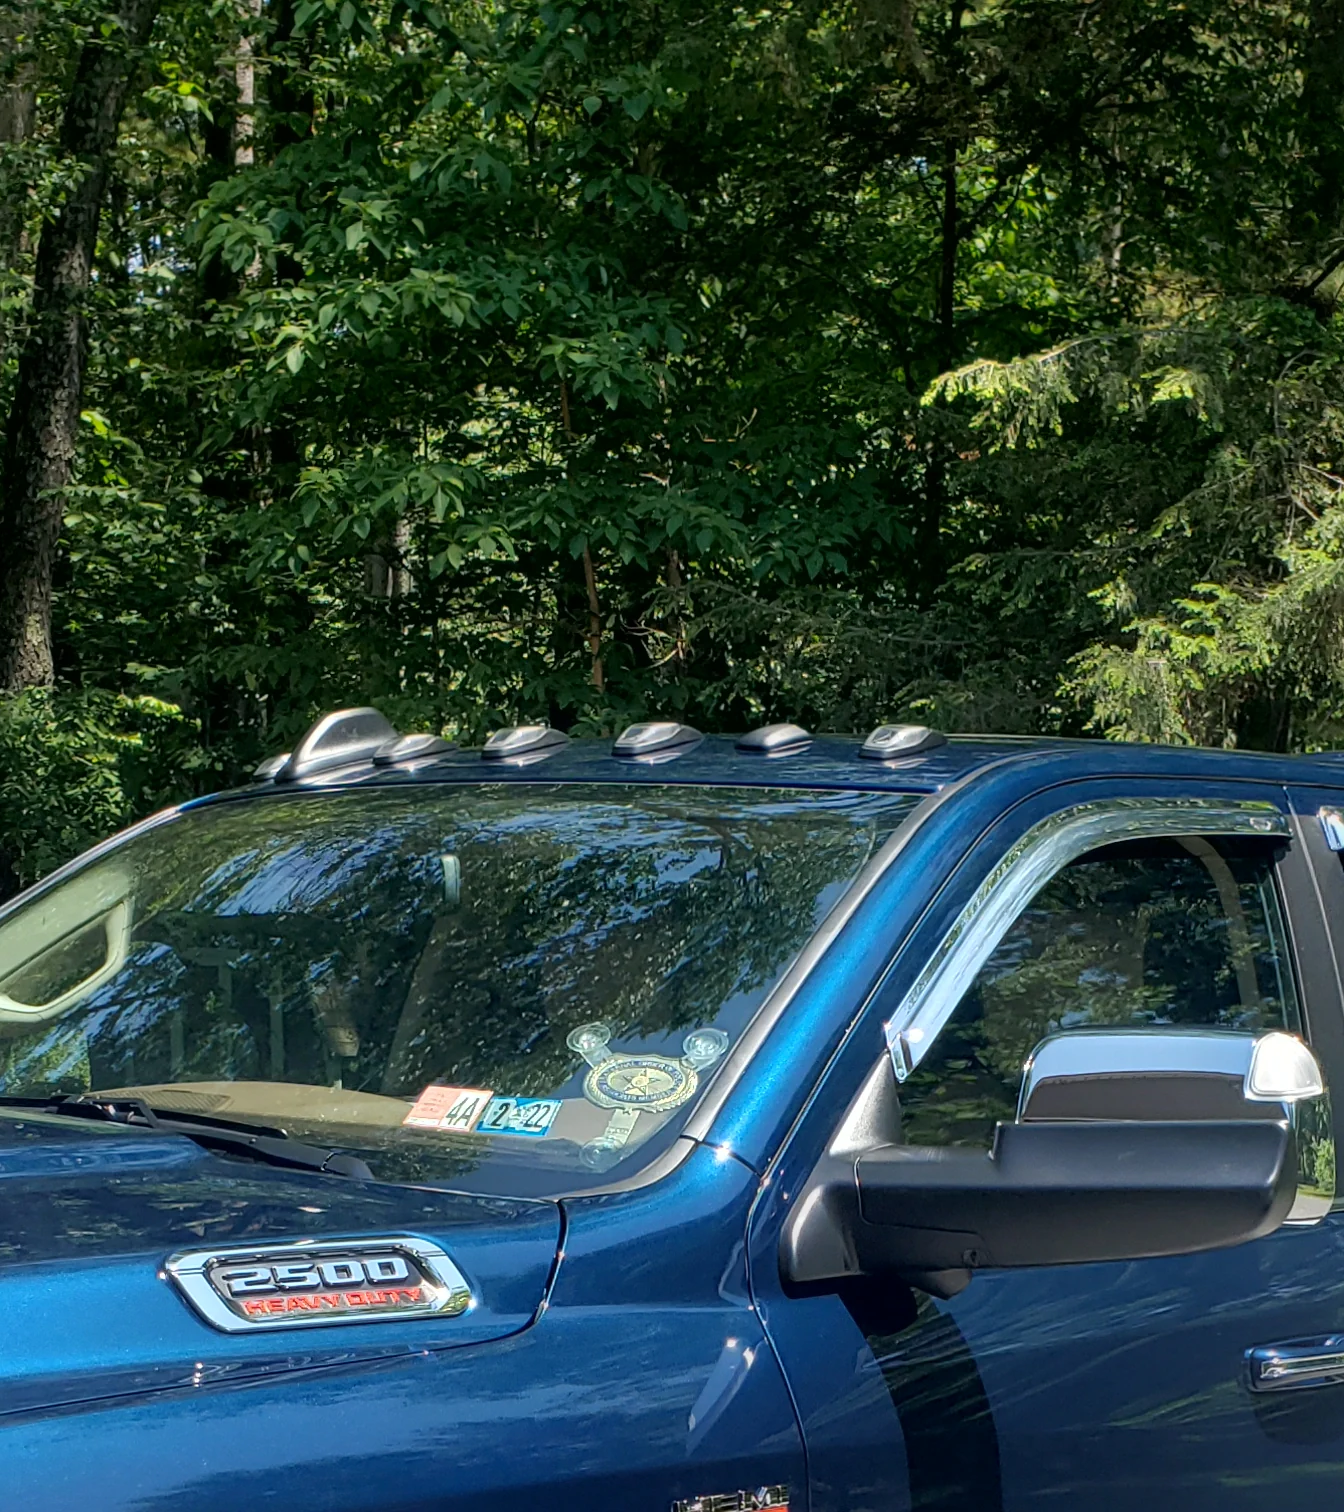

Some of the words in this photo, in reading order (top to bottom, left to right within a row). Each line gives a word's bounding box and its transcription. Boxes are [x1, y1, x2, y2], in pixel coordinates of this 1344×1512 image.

[221, 1256, 409, 1297] 2500
[244, 1292, 339, 1315] HEAVY
[346, 1287, 422, 1307] DUTY
